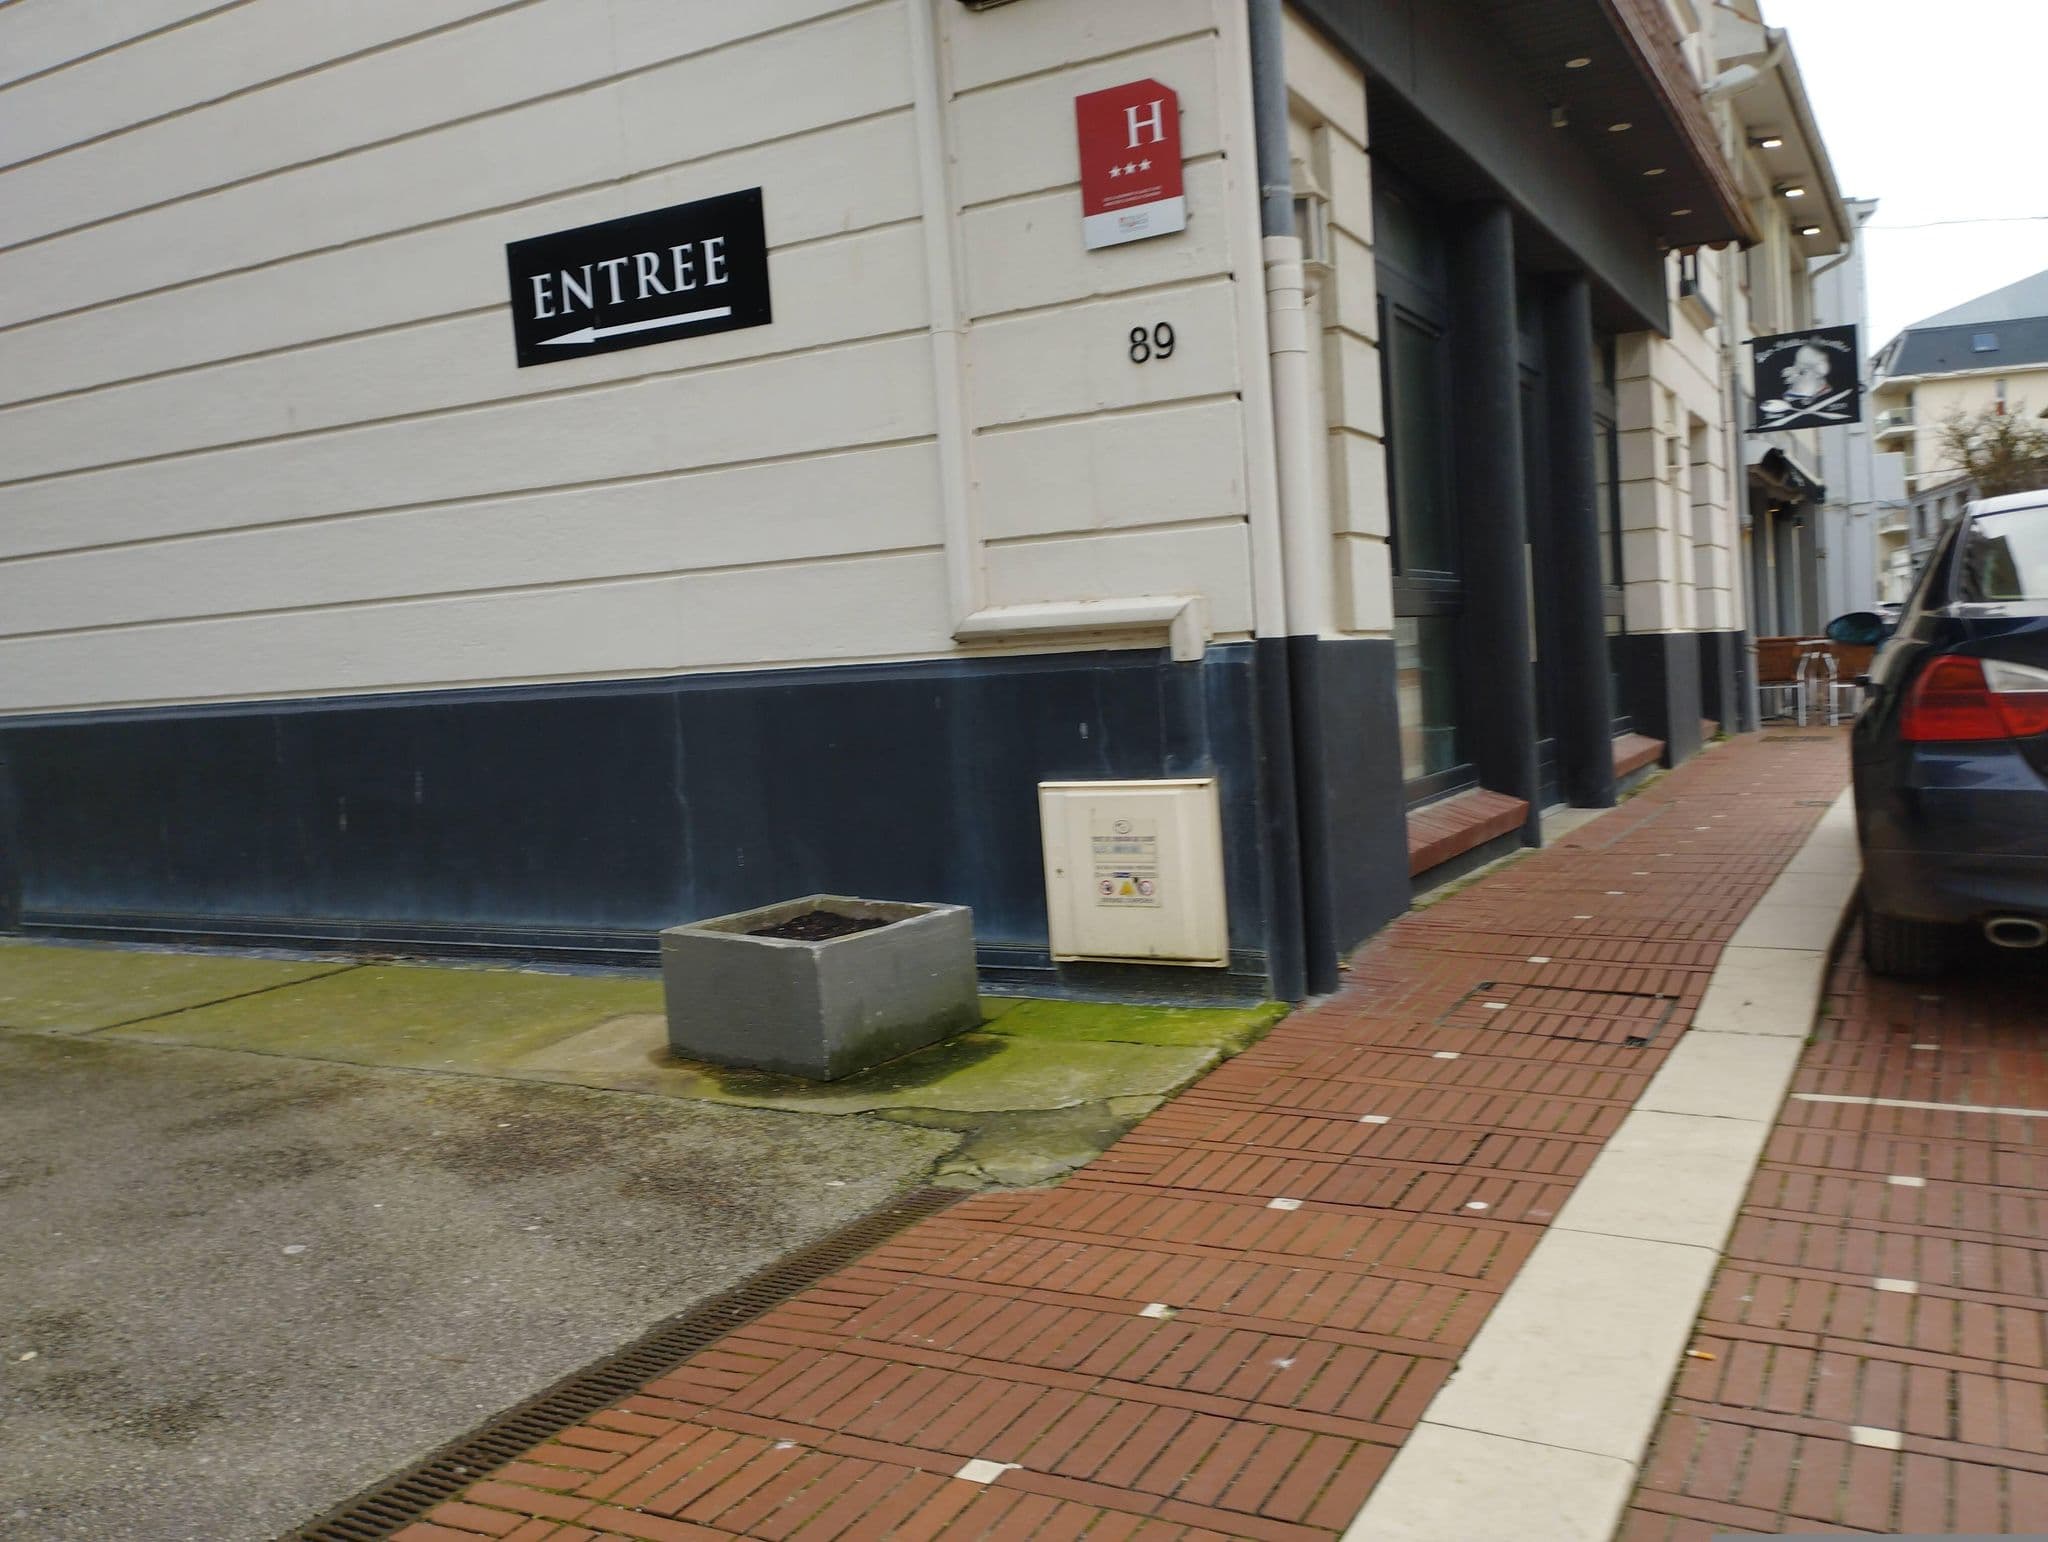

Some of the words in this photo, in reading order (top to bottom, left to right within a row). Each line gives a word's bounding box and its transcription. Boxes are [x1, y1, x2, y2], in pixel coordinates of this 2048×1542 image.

[1123, 98, 1168, 149] H
[529, 236, 729, 319] ENTREE
[1130, 322, 1175, 364] 89
